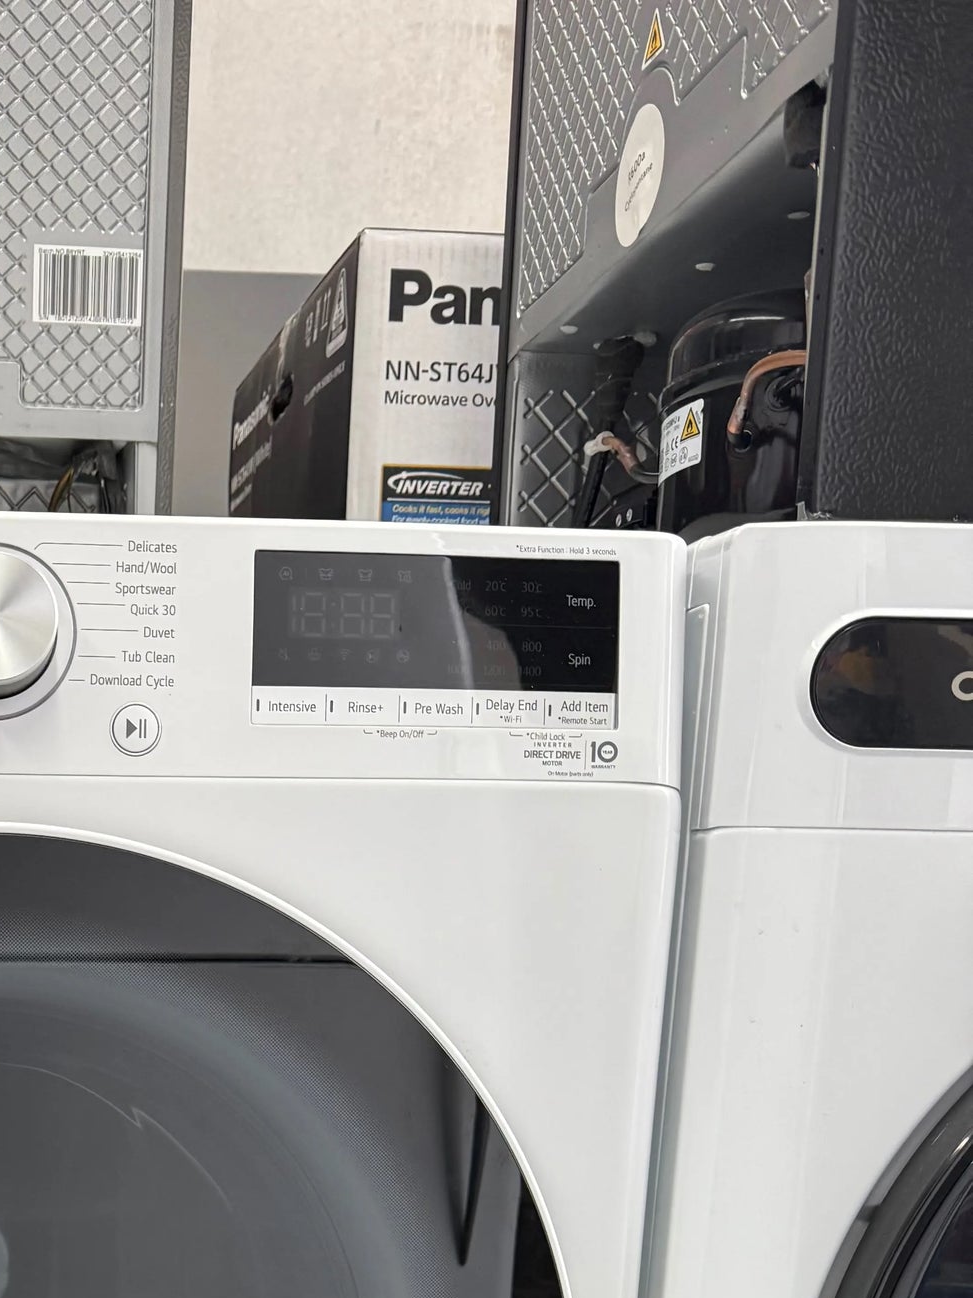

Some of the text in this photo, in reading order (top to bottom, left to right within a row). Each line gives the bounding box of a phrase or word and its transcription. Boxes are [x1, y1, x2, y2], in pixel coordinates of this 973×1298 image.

[388, 268, 502, 325] Pan
[385, 360, 498, 383] NN-ST64J
[384, 390, 495, 407] Microwave Ov
[396, 478, 483, 496] INVERTER
[128, 540, 177, 553] Delicates
[116, 561, 177, 574] Hand/Wool
[115, 582, 176, 597] Sportswear
[566, 594, 597, 608] Temp.
[130, 603, 176, 616] Quick 30
[143, 626, 175, 639] Duvet
[121, 650, 175, 664] Tub Clean
[568, 653, 591, 668] Spin
[90, 673, 174, 690] Download Cycle
[268, 700, 317, 713] Intensive
[348, 701, 384, 714] Rinse+
[414, 703, 464, 715] Pre Wash
[485, 698, 538, 713] Delay End
[560, 700, 608, 712] Add Item
[589, 717, 607, 725] Start
[399, 730, 424, 739] On/Off
[549, 732, 565, 741] Lock
[523, 750, 581, 759] DIRECT DRIVE
